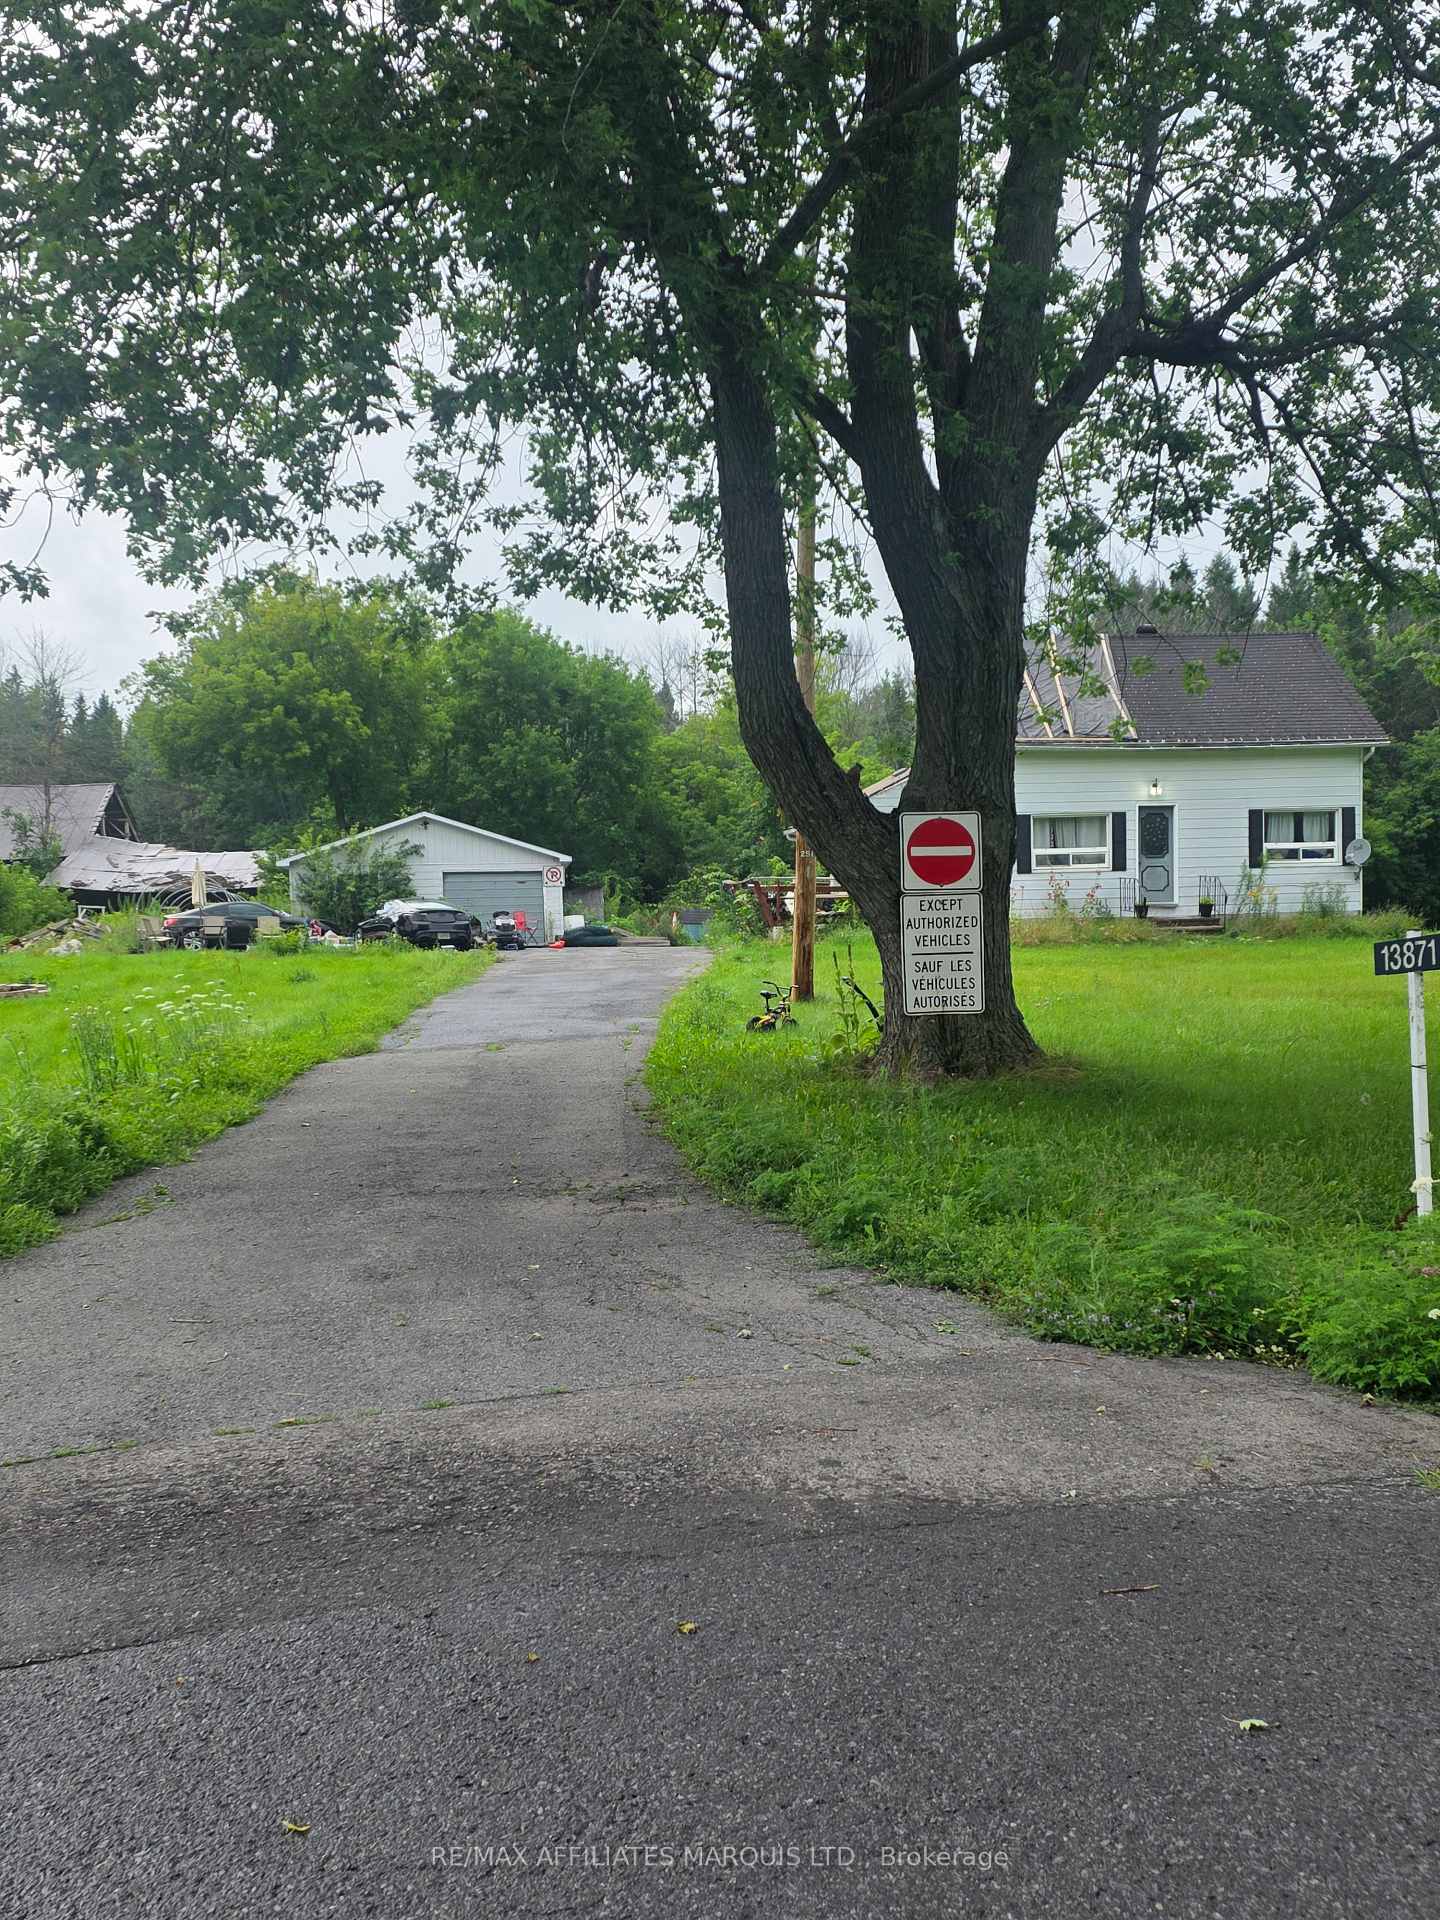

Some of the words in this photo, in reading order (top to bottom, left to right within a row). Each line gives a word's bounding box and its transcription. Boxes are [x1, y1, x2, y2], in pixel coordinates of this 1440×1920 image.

[919, 898, 963, 912] EXCEPT
[905, 915, 978, 930] AUTHORIZED
[914, 933, 970, 947] VEHICLES
[1381, 939, 1436, 971] 13871
[914, 960, 944, 973] SAUF
[951, 959, 972, 972] LES
[911, 975, 976, 991] VÉHICULES
[913, 991, 976, 1009] AUTORISÉS
